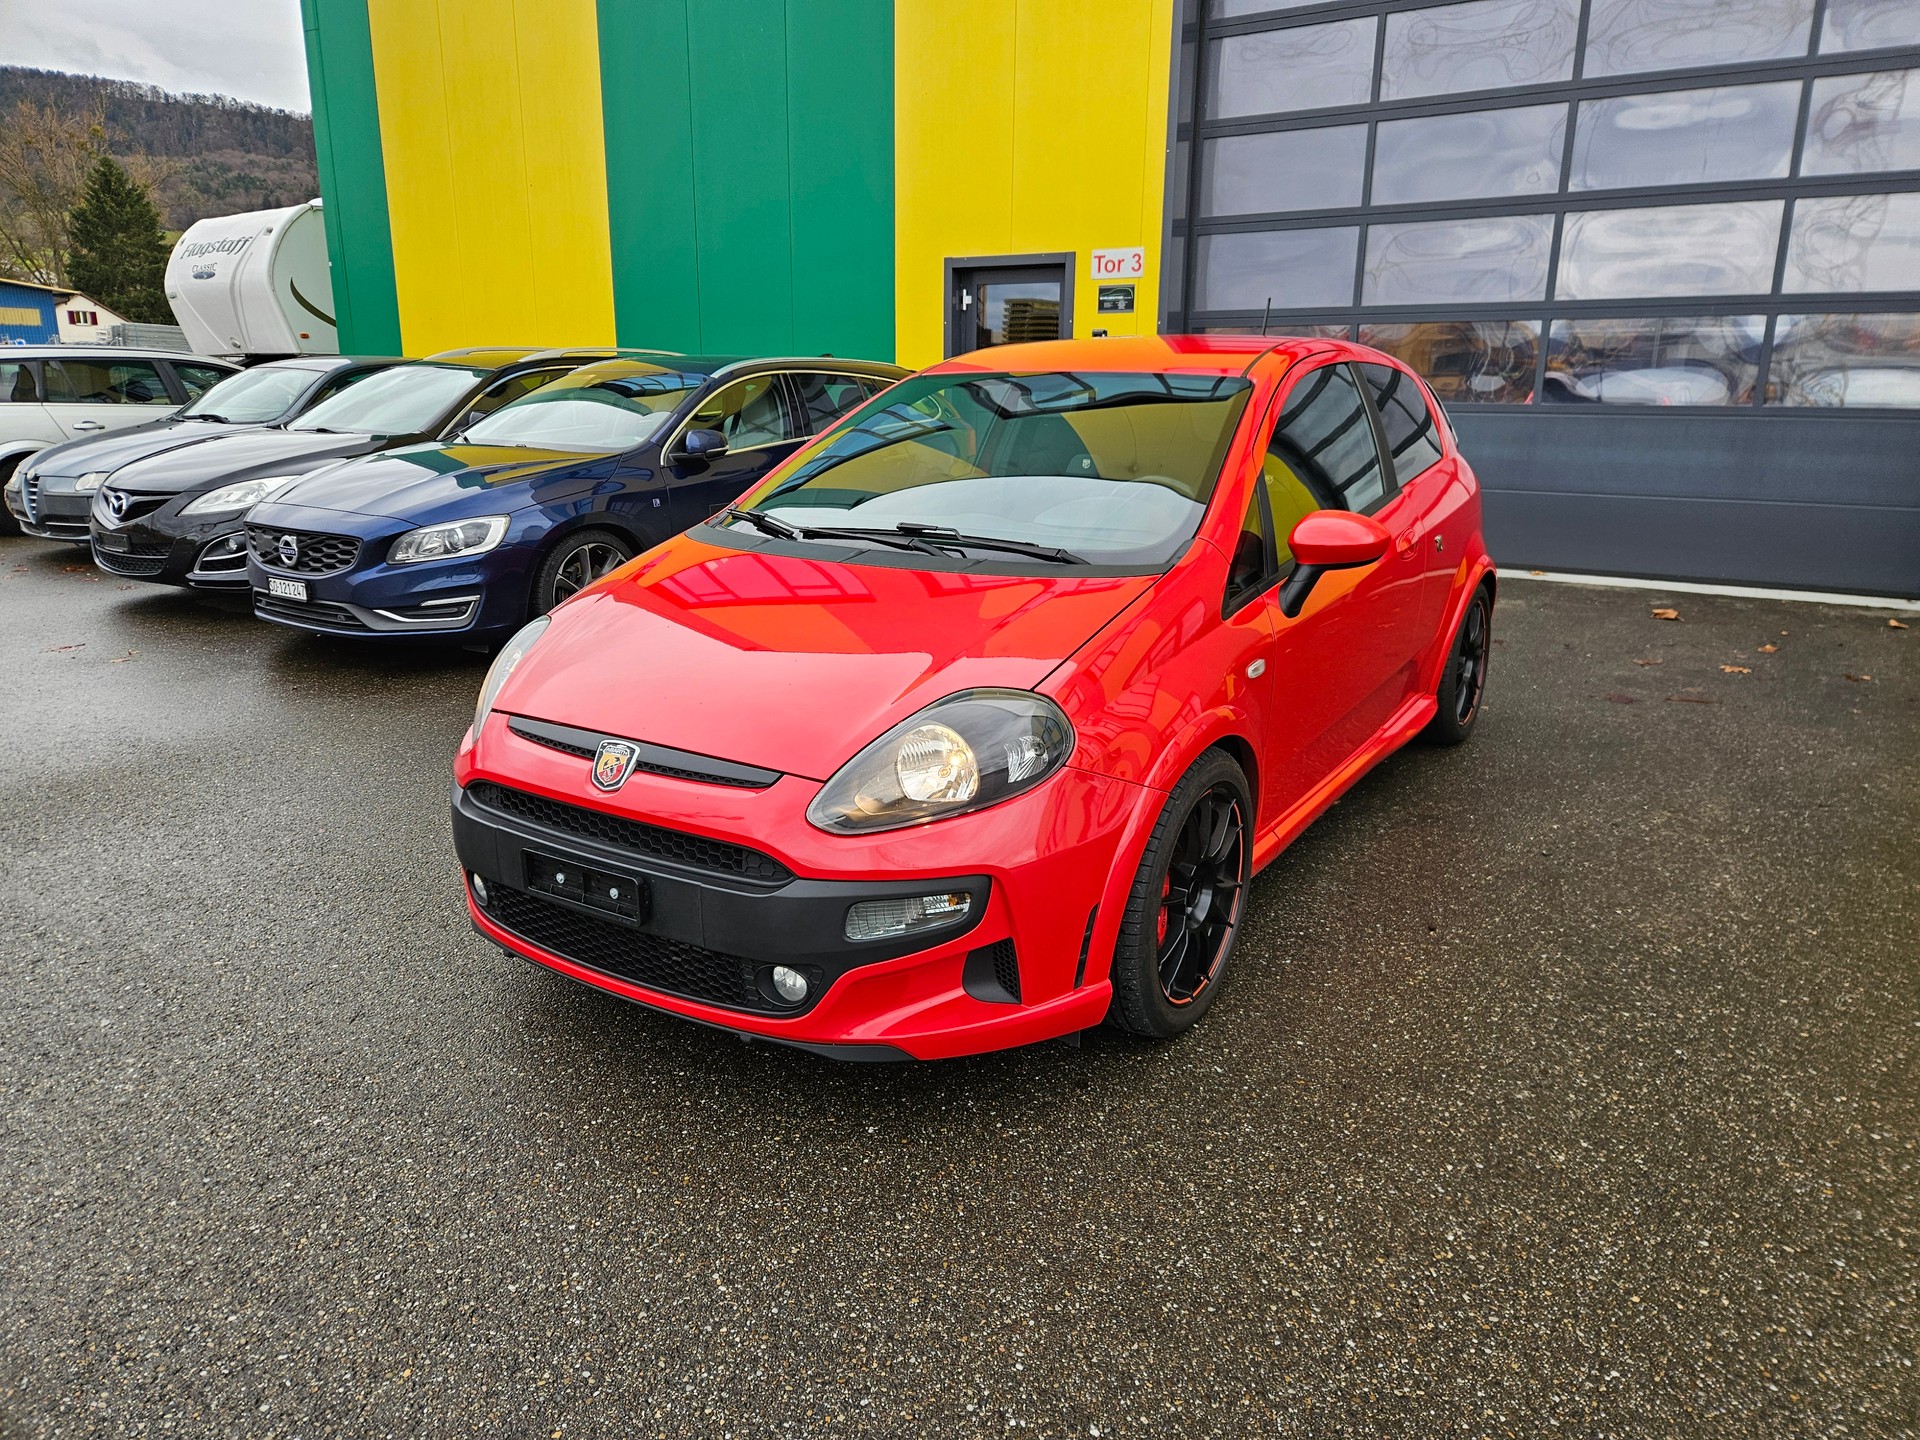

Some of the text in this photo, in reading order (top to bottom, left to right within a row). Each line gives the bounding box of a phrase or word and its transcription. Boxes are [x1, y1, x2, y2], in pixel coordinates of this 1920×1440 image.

[180, 236, 253, 259] Flagstaff
[192, 262, 217, 273] CLASSIC
[1093, 253, 1142, 273] Tor 3
